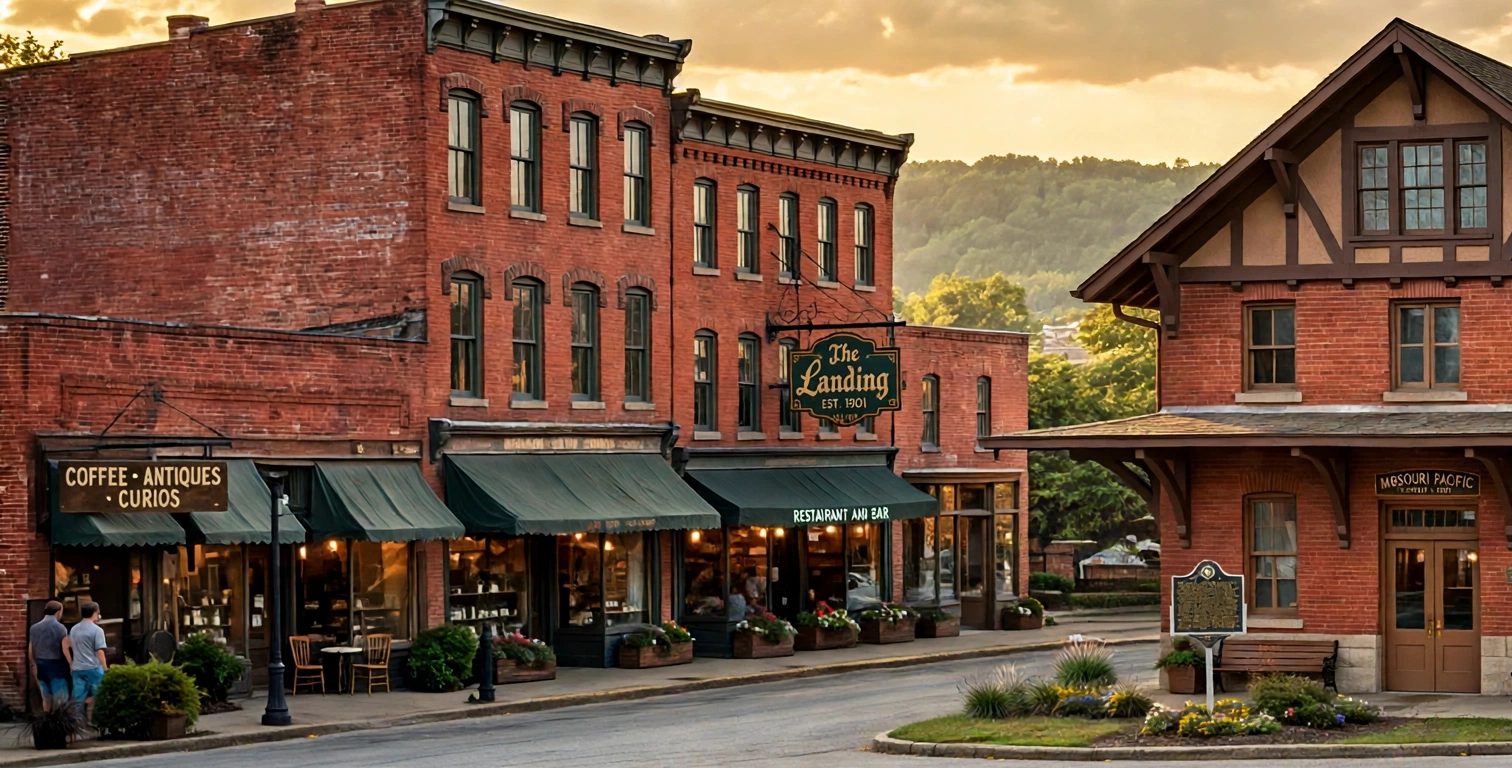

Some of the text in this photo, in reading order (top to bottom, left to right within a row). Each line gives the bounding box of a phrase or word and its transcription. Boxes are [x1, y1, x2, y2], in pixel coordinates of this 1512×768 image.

[829, 343, 860, 365] The
[796, 359, 889, 400] Landing
[821, 398, 841, 409] EST.
[65, 466, 221, 488] COFFEE ANTIQUES
[118, 489, 180, 508] CURIOS
